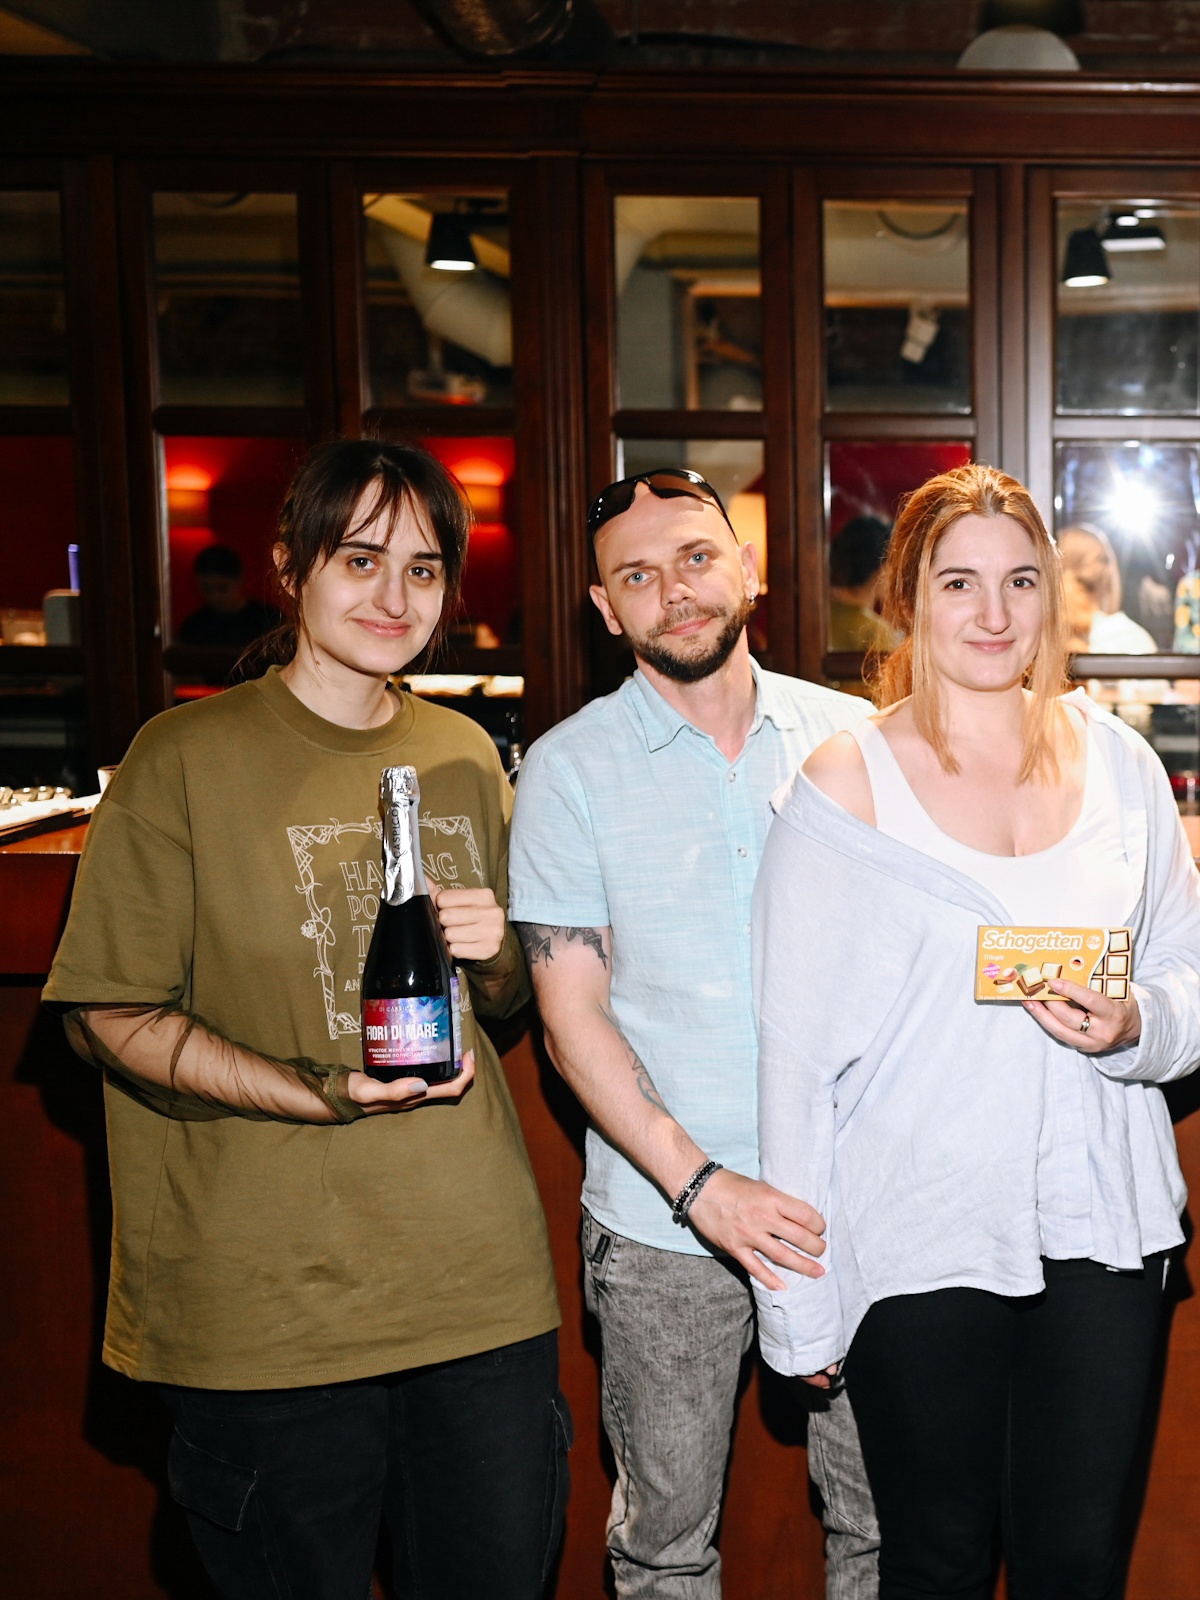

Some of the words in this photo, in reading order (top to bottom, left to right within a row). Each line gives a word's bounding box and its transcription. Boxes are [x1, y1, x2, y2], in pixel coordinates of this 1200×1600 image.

[391, 808, 402, 859] CASPICO
[982, 929, 1084, 954] Schogetten
[366, 1025, 388, 1041] FIORI
[391, 1024, 402, 1041] DI
[406, 1022, 439, 1041] MARE
